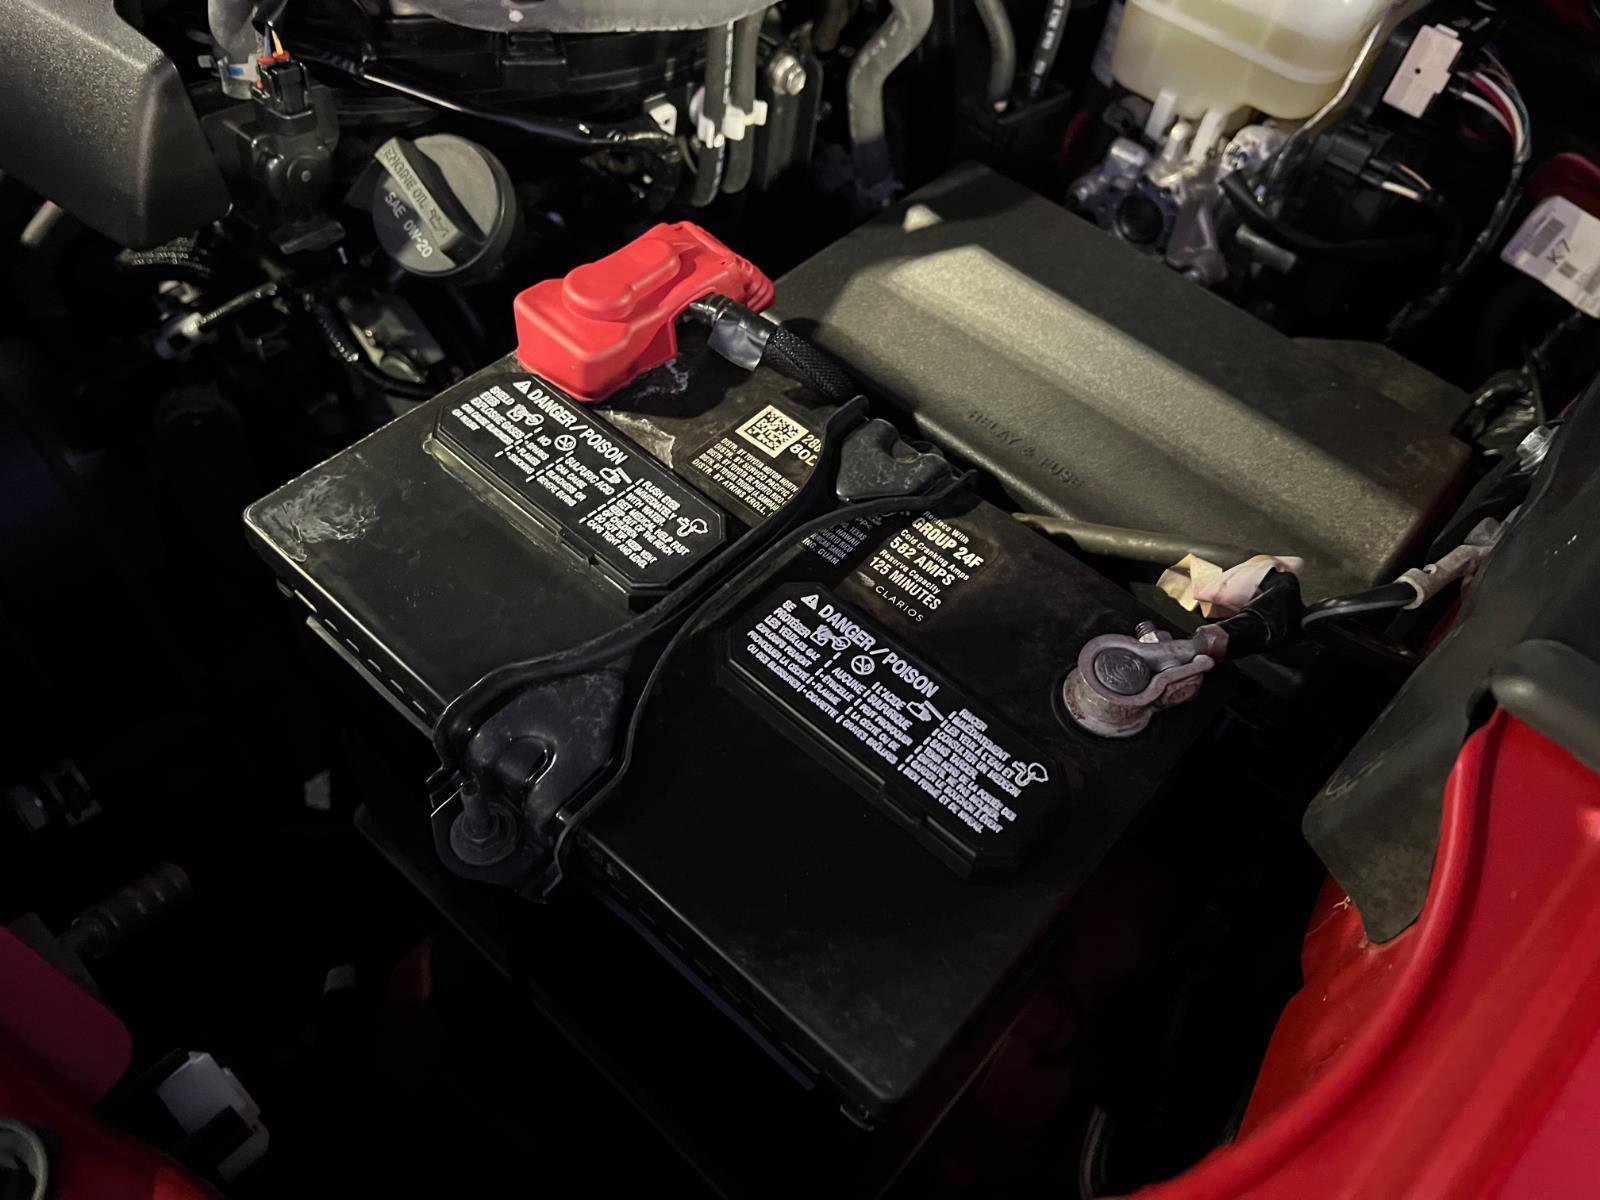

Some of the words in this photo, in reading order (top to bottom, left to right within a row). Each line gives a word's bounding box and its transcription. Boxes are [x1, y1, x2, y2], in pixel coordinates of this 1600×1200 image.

[384, 147, 418, 188] ENGINE
[412, 190, 428, 208] OIL
[385, 192, 406, 218] SAE
[403, 220, 433, 257] 0W-20
[479, 391, 500, 407] EYES
[489, 385, 515, 405] SHIELD
[536, 435, 551, 446] NO
[555, 464, 569, 475] CAN
[566, 473, 587, 489] CAUSE
[564, 456, 599, 483] SULFURIC
[594, 480, 615, 495] ACID
[691, 458, 713, 475] DISTR.
[712, 473, 725, 482] BY
[721, 480, 746, 498] ATKINS
[713, 443, 734, 459] DISTR.
[733, 456, 745, 464] BY
[742, 462, 767, 481] SERVCO
[765, 478, 790, 497] PACIFIC
[721, 458, 732, 466] BY
[745, 474, 755, 483] DE
[752, 479, 773, 495] PUERTO
[769, 492, 784, 503] RICO
[736, 448, 747, 456] BY
[744, 453, 764, 469] TOYOTA
[761, 465, 782, 481] MOTOR
[779, 477, 799, 492] NORTH
[625, 492, 644, 508] WITH
[641, 480, 665, 499] FLUSH
[661, 495, 680, 510] EYES
[594, 514, 606, 523] DO
[603, 521, 619, 533] NOT
[601, 509, 614, 518] OF
[616, 498, 633, 511] GET
[654, 528, 673, 543] HELP
[669, 540, 690, 555] FAST
[622, 515, 637, 528] OUT
[634, 524, 646, 532] OF
[923, 511, 952, 533] Replace
[951, 528, 969, 544] With
[586, 519, 604, 533] CAPS
[617, 544, 632, 556] AND
[835, 528, 860, 546] HAWAII
[849, 526, 867, 540] TEXAS
[912, 517, 957, 550] GROUP
[952, 546, 984, 567] 24F
[817, 548, 839, 565] GUAM
[890, 536, 916, 559] 582
[913, 555, 955, 585] AMPS
[900, 529, 918, 545] Cold
[916, 542, 948, 567] Cranking
[947, 564, 969, 580] Amps
[869, 556, 892, 574] 125
[888, 569, 941, 609] MINUTES
[879, 549, 909, 572] Reserve
[908, 569, 940, 594] Capacity
[782, 600, 797, 612] SE
[875, 585, 923, 621] CLARIOS
[779, 656, 790, 666] LA
[831, 667, 867, 695] AUCUNE
[875, 685, 908, 710] L'ACIDE
[850, 711, 861, 721] LA
